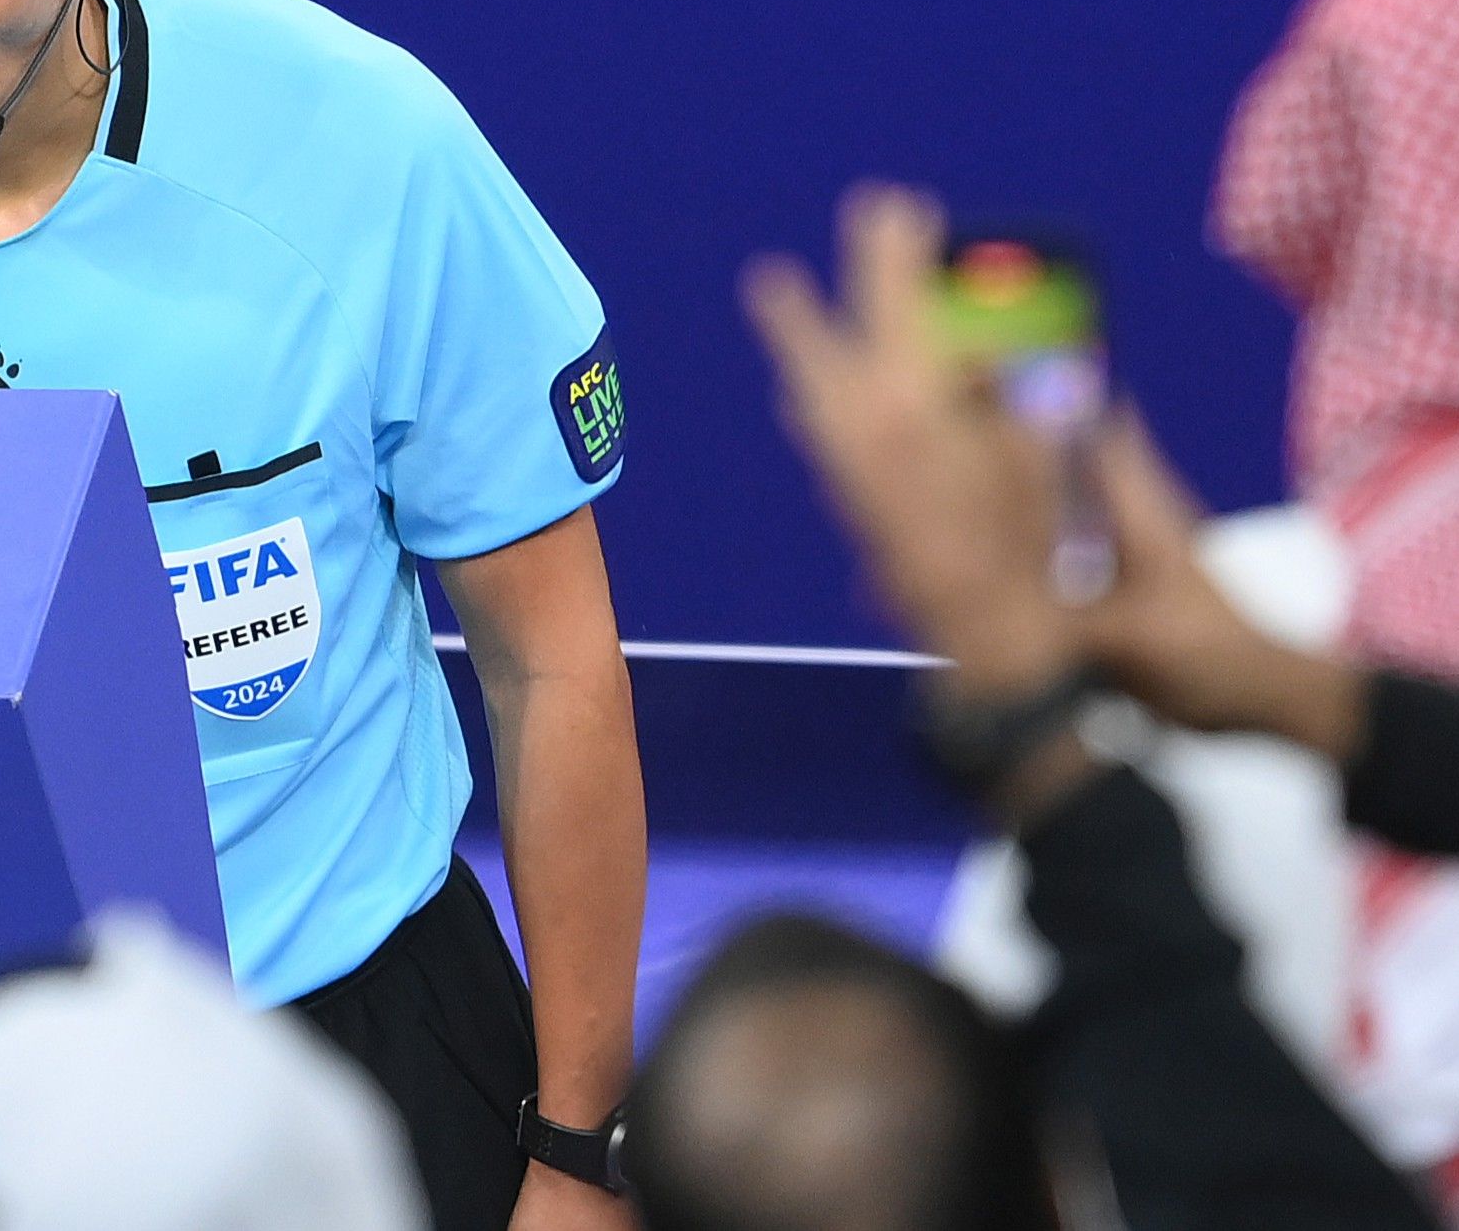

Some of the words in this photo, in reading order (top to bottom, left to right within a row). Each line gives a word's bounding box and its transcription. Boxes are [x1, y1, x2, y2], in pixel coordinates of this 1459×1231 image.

[569, 362, 602, 405] AFC
[573, 362, 620, 435] LIVE
[223, 675, 285, 709] 2024
